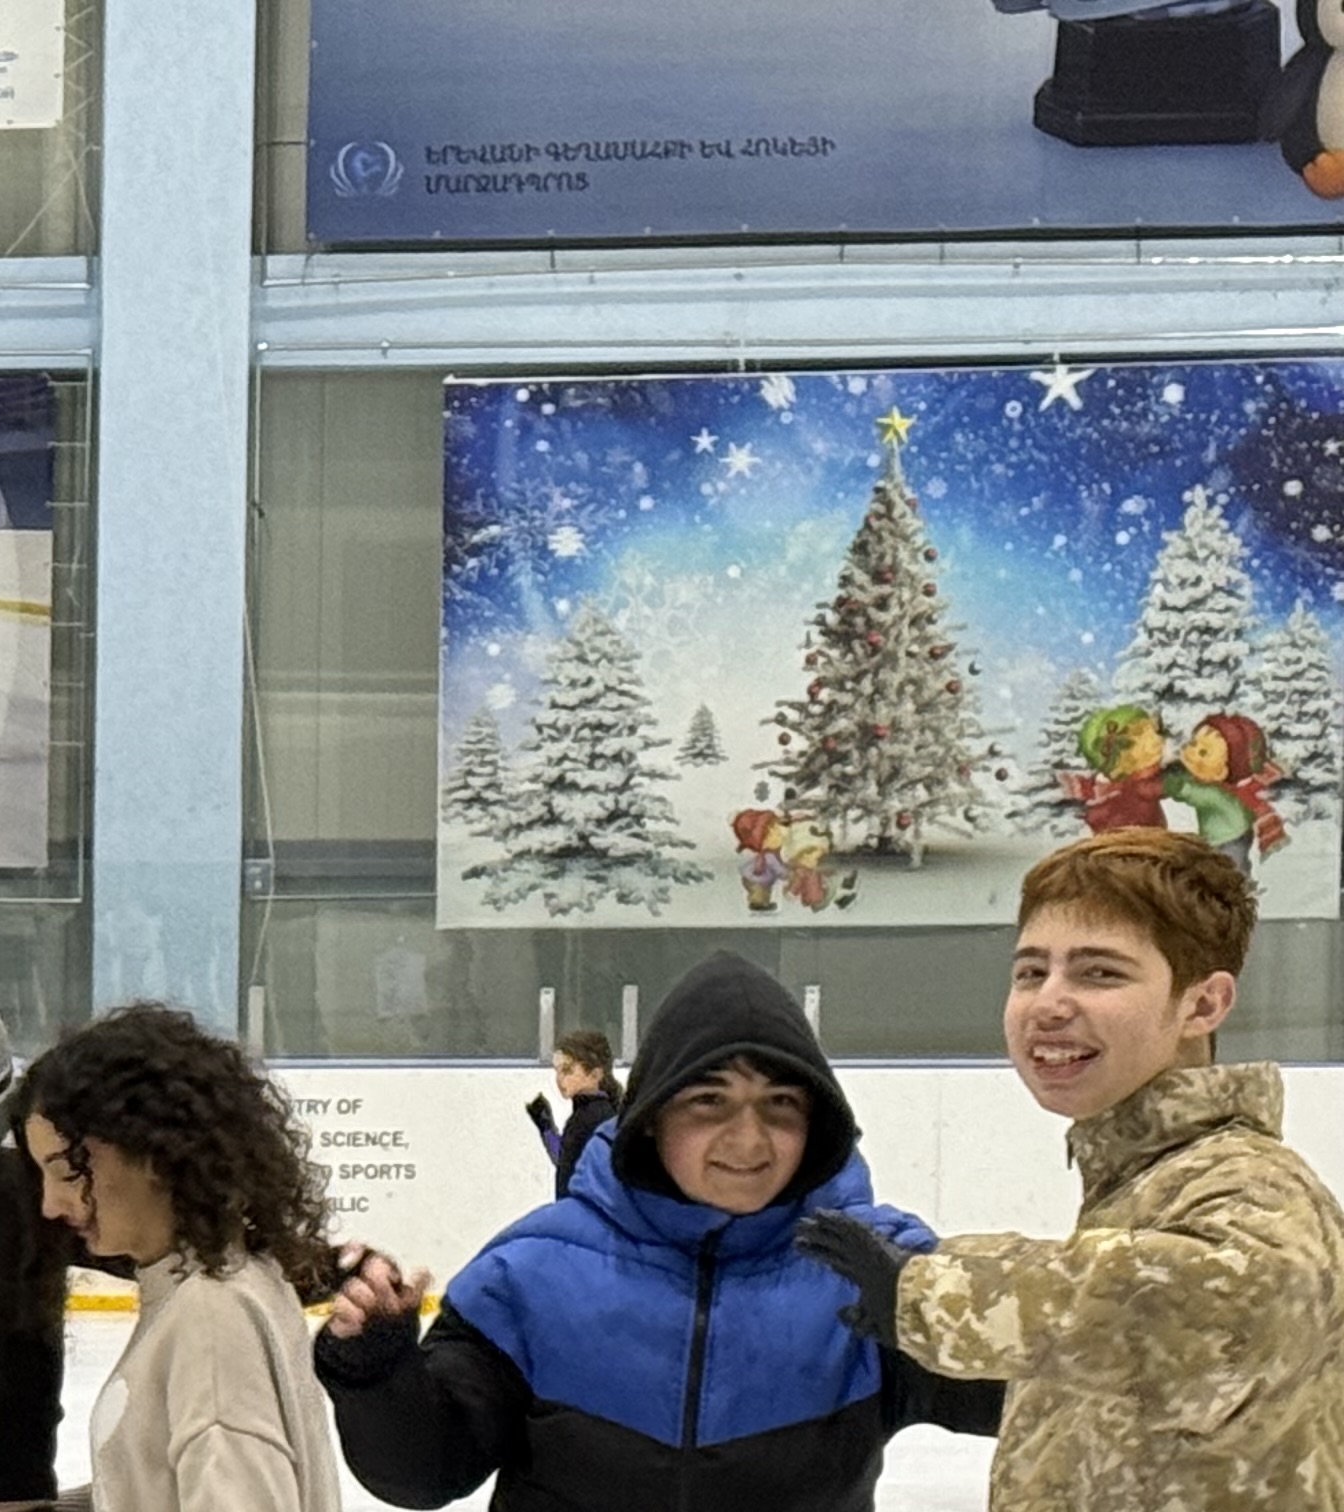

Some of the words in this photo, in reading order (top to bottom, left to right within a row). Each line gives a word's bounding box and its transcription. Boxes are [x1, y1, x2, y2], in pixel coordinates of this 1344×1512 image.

[336, 1098, 364, 1115] OF
[319, 1131, 410, 1150] SCIENCE,
[338, 1163, 416, 1180] SPORTS
